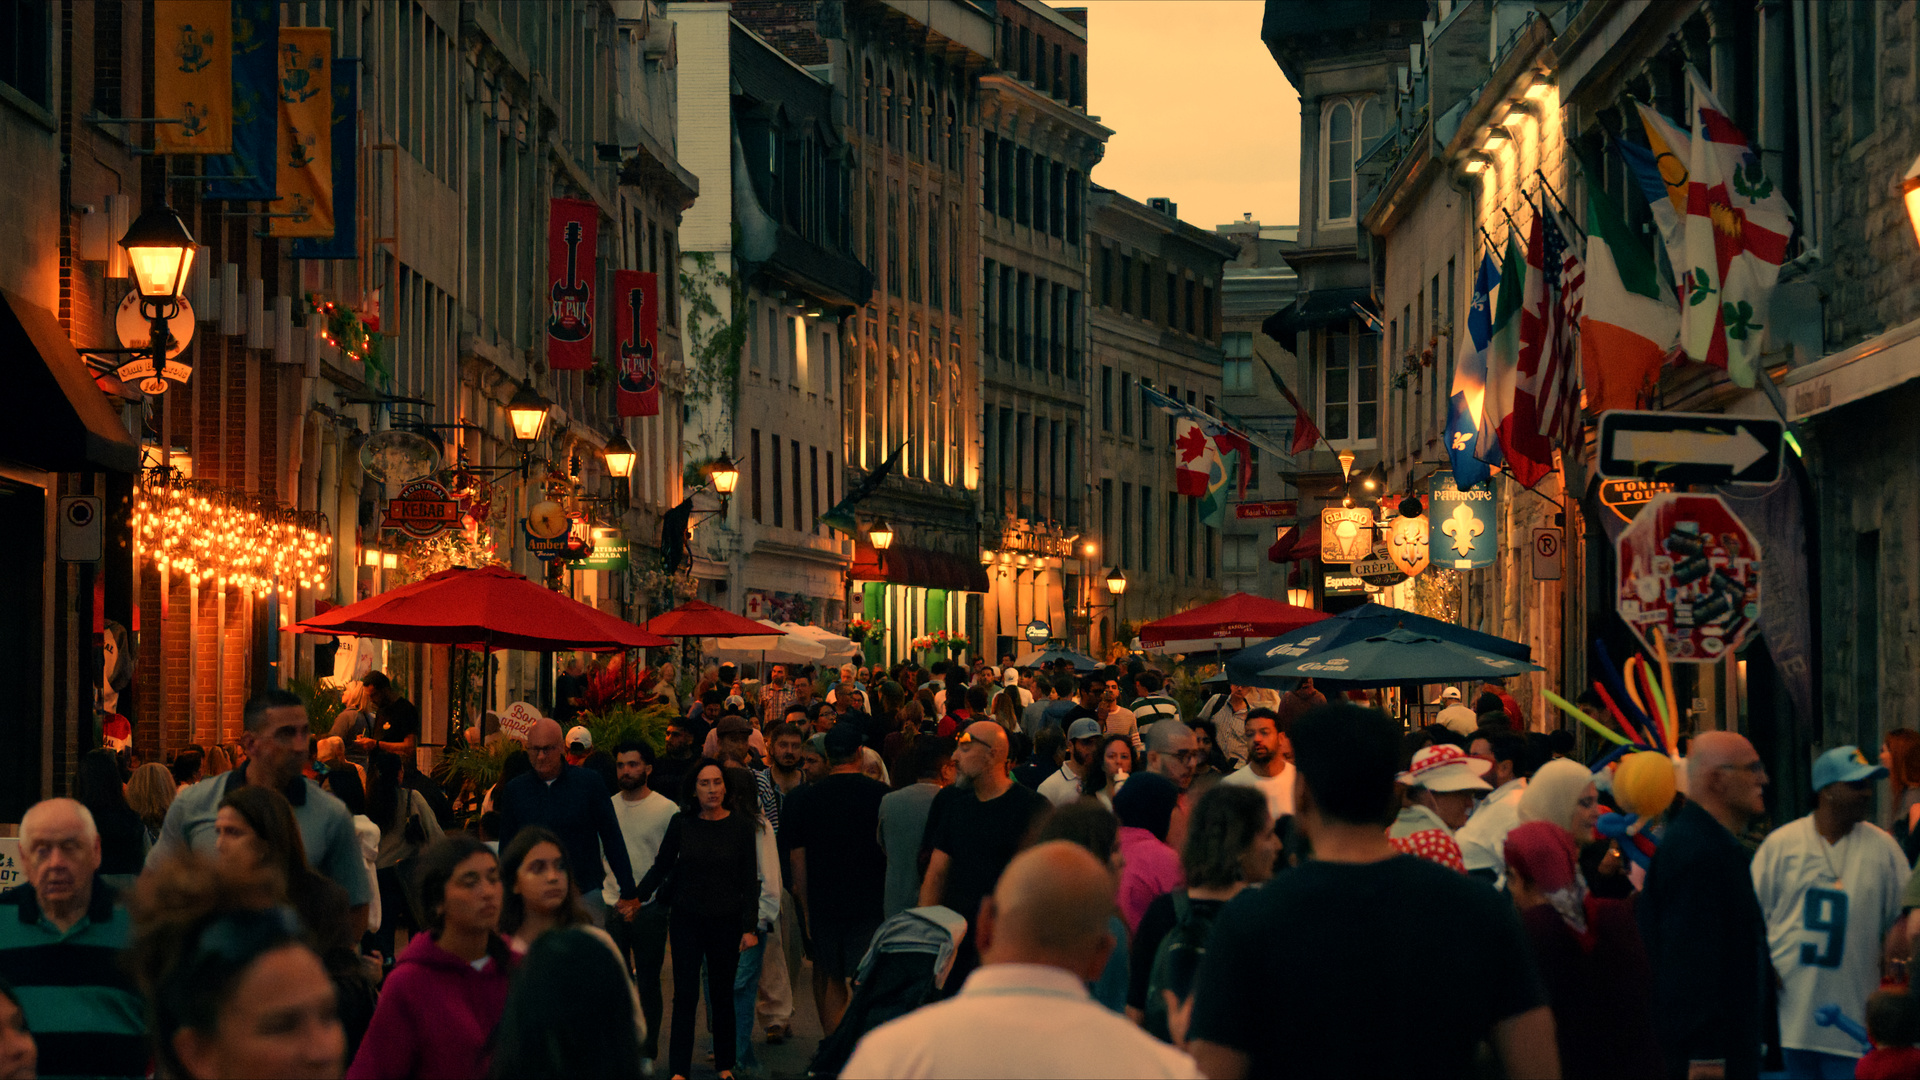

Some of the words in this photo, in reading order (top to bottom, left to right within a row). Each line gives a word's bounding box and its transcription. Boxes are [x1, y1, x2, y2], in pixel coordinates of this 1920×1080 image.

[566, 301, 587, 327] PAUL
[145, 362, 189, 379] Brois
[633, 358, 652, 380] PAUL
[402, 502, 444, 518] KEBAB
[1325, 511, 1368, 525] GELATO
[528, 538, 566, 550] Amber
[1356, 561, 1401, 575] CRÊPE
[1325, 577, 1362, 590] Espresso
[511, 705, 537, 724] Bon
[501, 717, 530, 736] appét
[1802, 887, 1848, 969] 9
